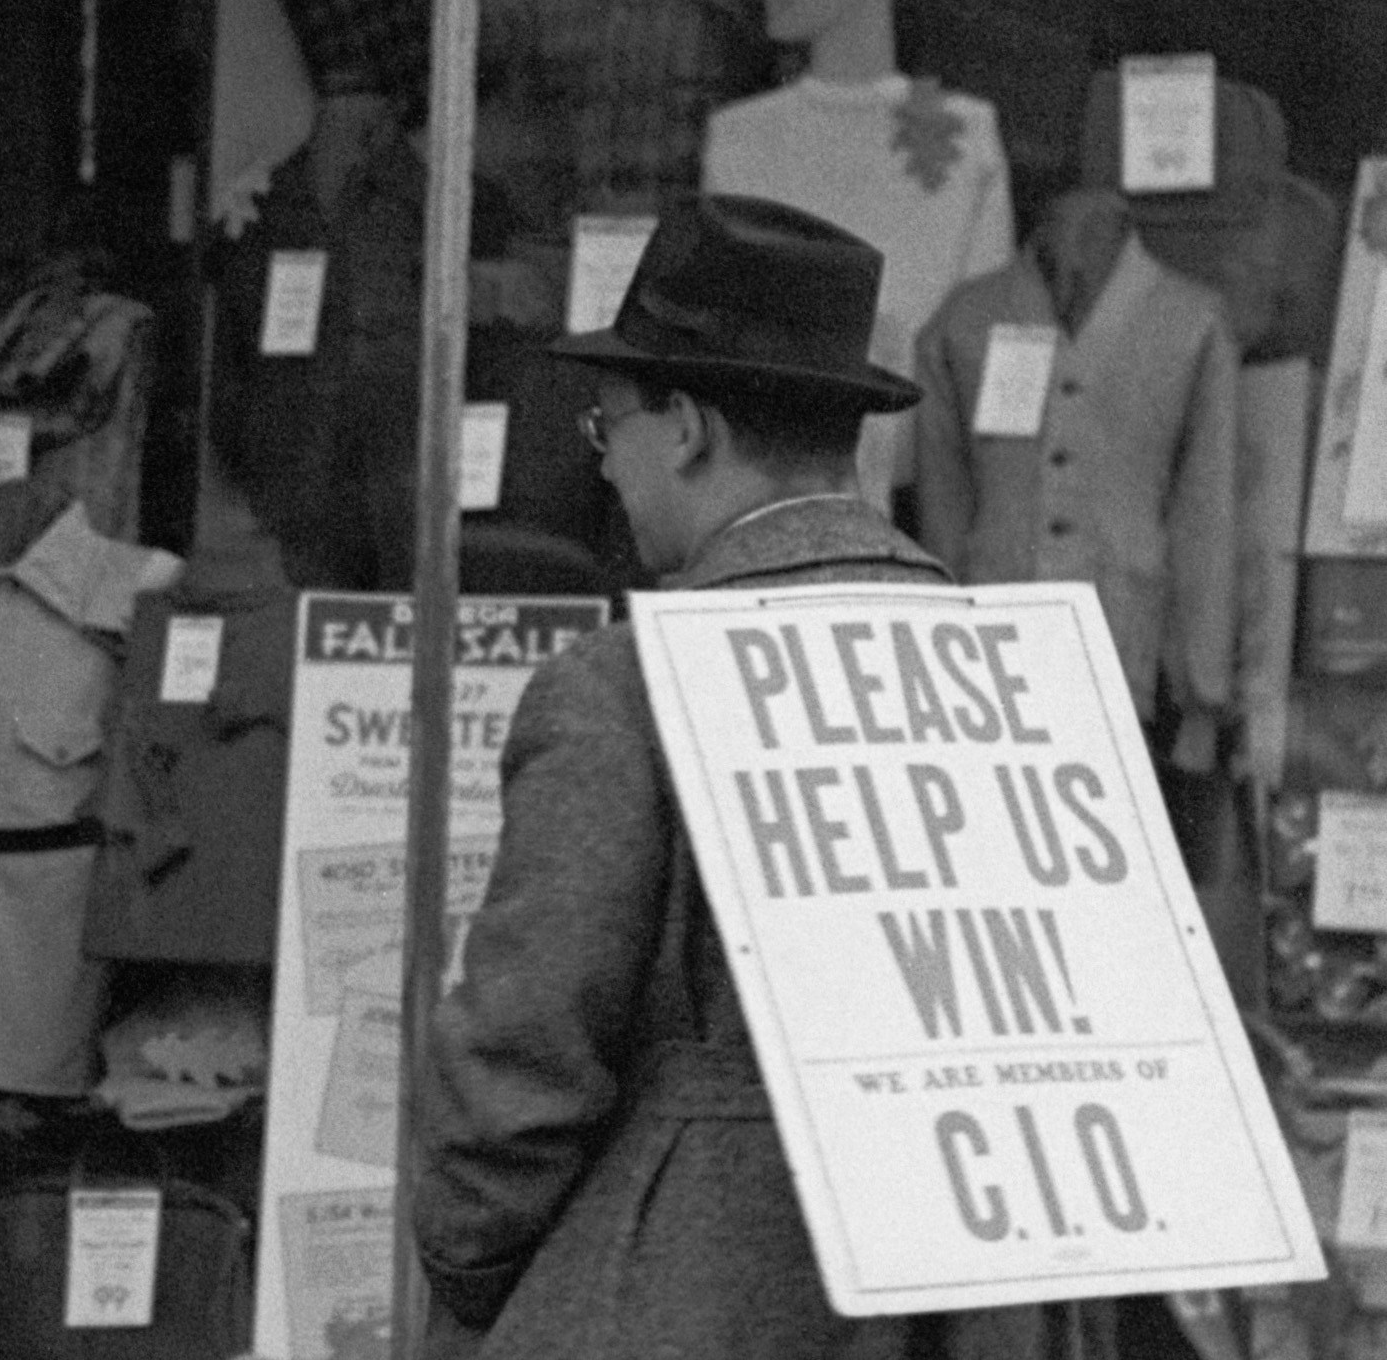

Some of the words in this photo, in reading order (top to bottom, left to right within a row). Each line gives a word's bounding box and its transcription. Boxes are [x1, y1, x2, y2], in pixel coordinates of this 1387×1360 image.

[321, 620, 413, 660] FAL
[725, 621, 1052, 749] PLEASE
[733, 762, 968, 899] HELP
[995, 761, 1129, 887] US
[876, 907, 1093, 1040] WIN!
[853, 1071, 907, 1094] WE
[923, 1065, 984, 1090] ARE
[995, 1060, 1126, 1084] MEMBERS
[1136, 1058, 1169, 1081] OF
[934, 1102, 1168, 1243] C.I.O.
